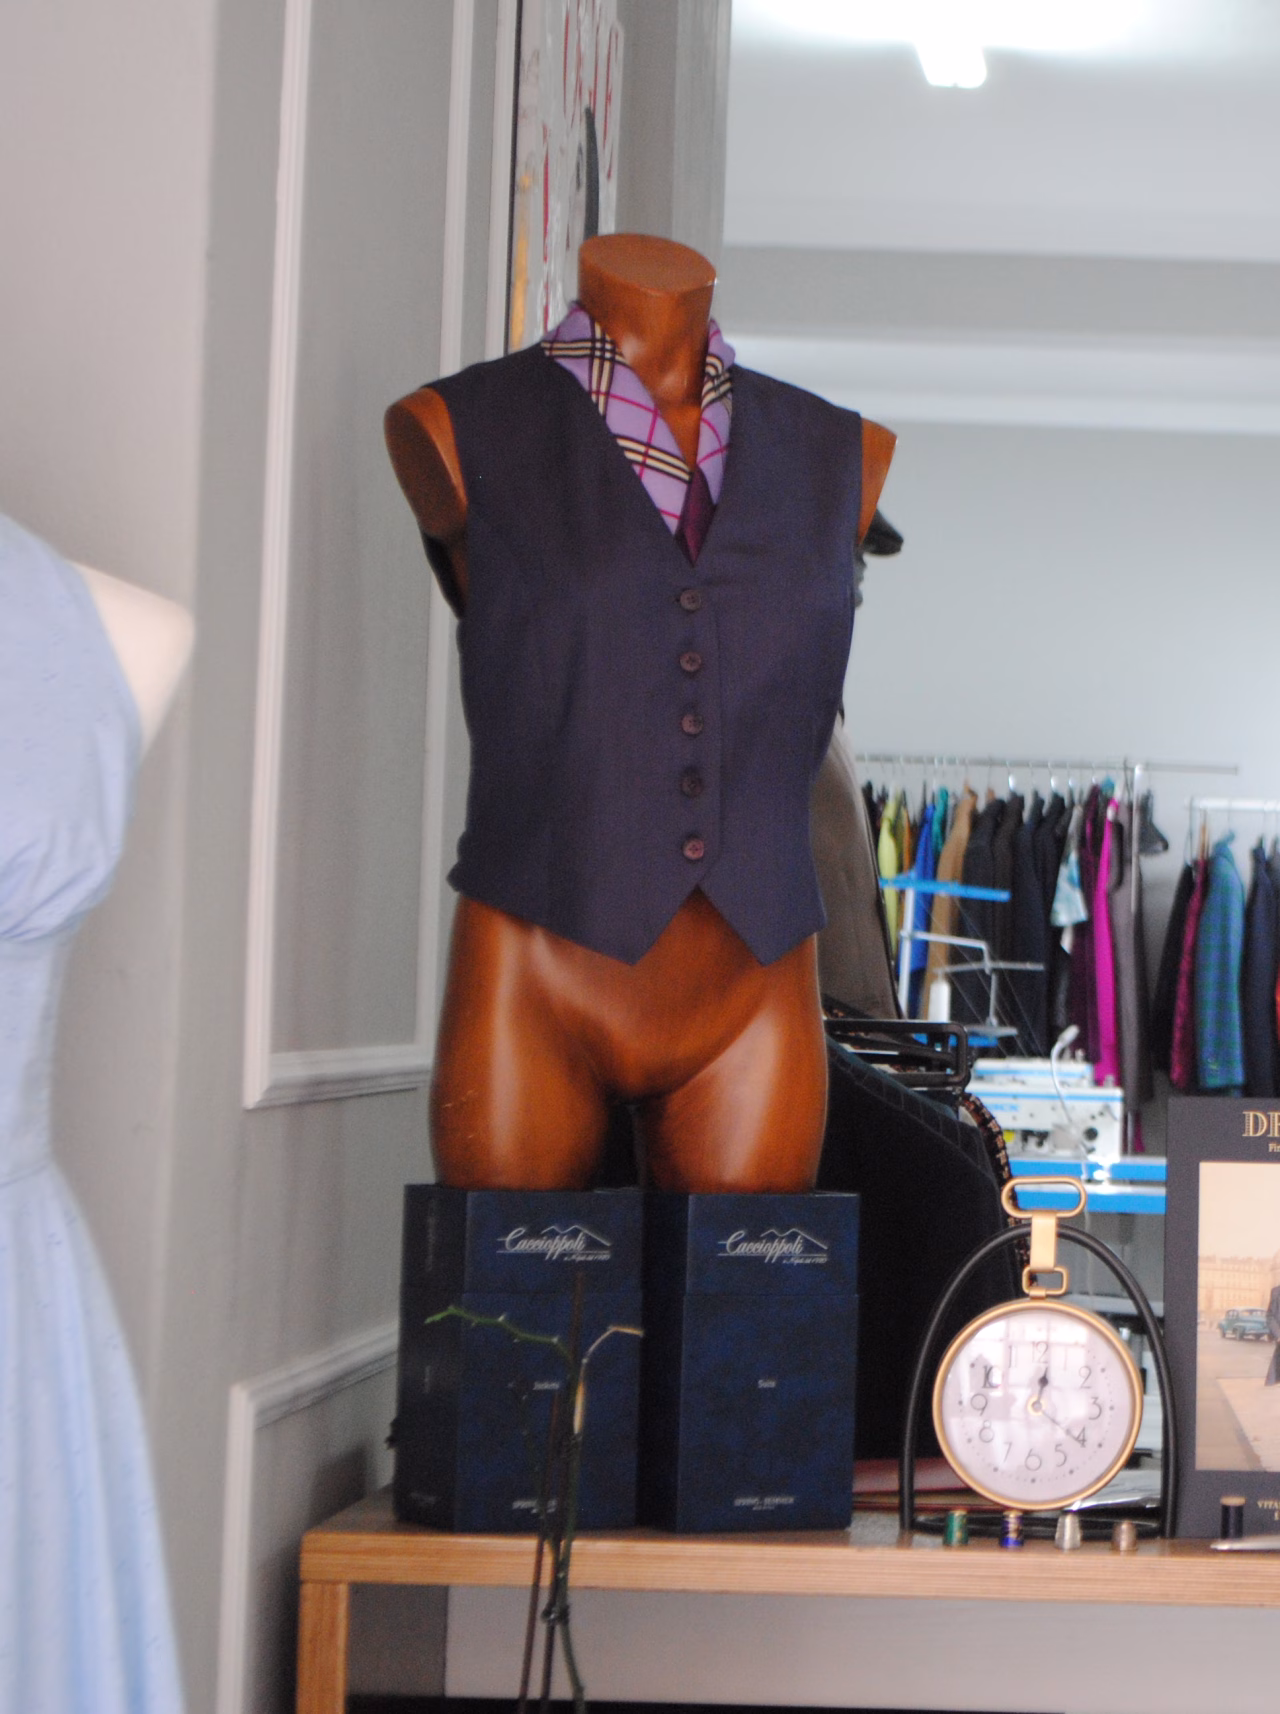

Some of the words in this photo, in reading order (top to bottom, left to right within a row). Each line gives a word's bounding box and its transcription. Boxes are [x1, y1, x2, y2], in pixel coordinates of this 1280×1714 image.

[505, 1227, 587, 1261] Caccioppoli
[726, 1230, 805, 1264] Caccioppoli
[1032, 1341, 1049, 1363] 12
[1078, 1366, 1092, 1389] 2
[970, 1393, 988, 1416] 9
[1088, 1396, 1102, 1420] 3
[978, 1419, 995, 1443] 8
[1075, 1427, 1087, 1448] 4
[1004, 1442, 1013, 1463] 7
[1024, 1449, 1042, 1471] 6
[1055, 1443, 1067, 1468] 5
